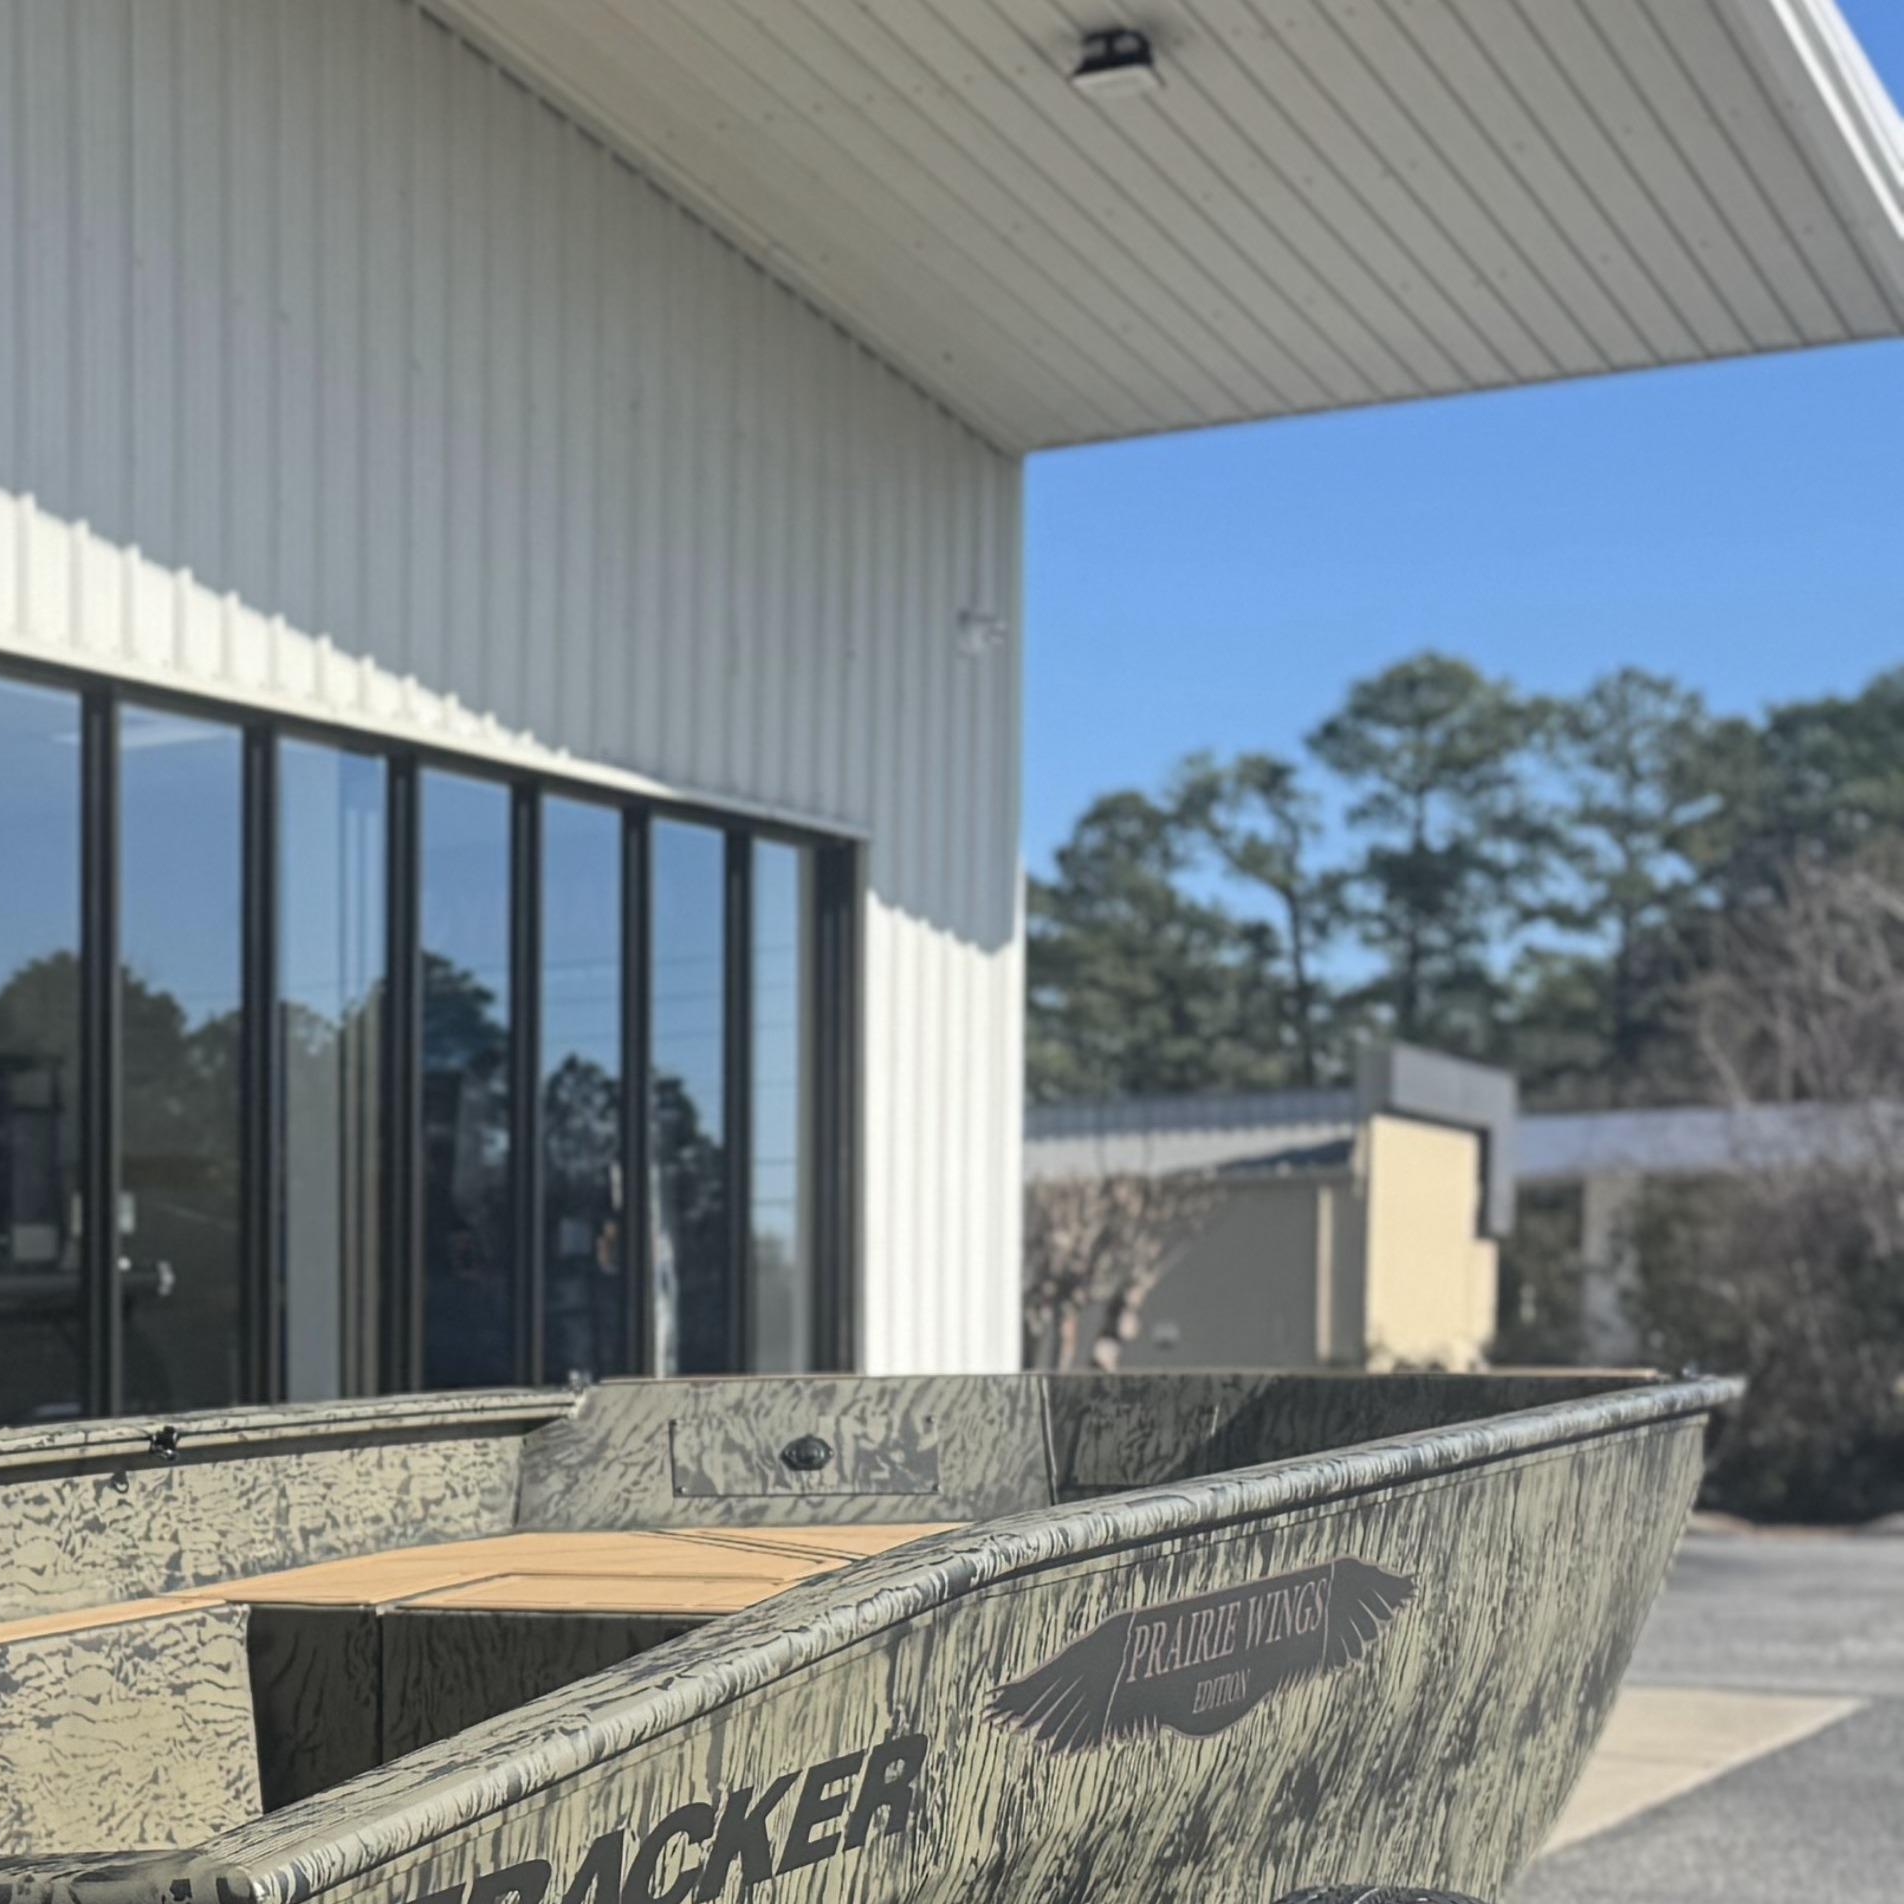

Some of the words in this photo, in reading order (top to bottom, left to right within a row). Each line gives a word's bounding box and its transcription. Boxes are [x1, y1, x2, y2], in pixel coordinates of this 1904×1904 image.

[1125, 1600, 1242, 1684] PRAIRIE
[1244, 1577, 1330, 1652] WINGS
[1191, 1668, 1252, 1715] EDITION
